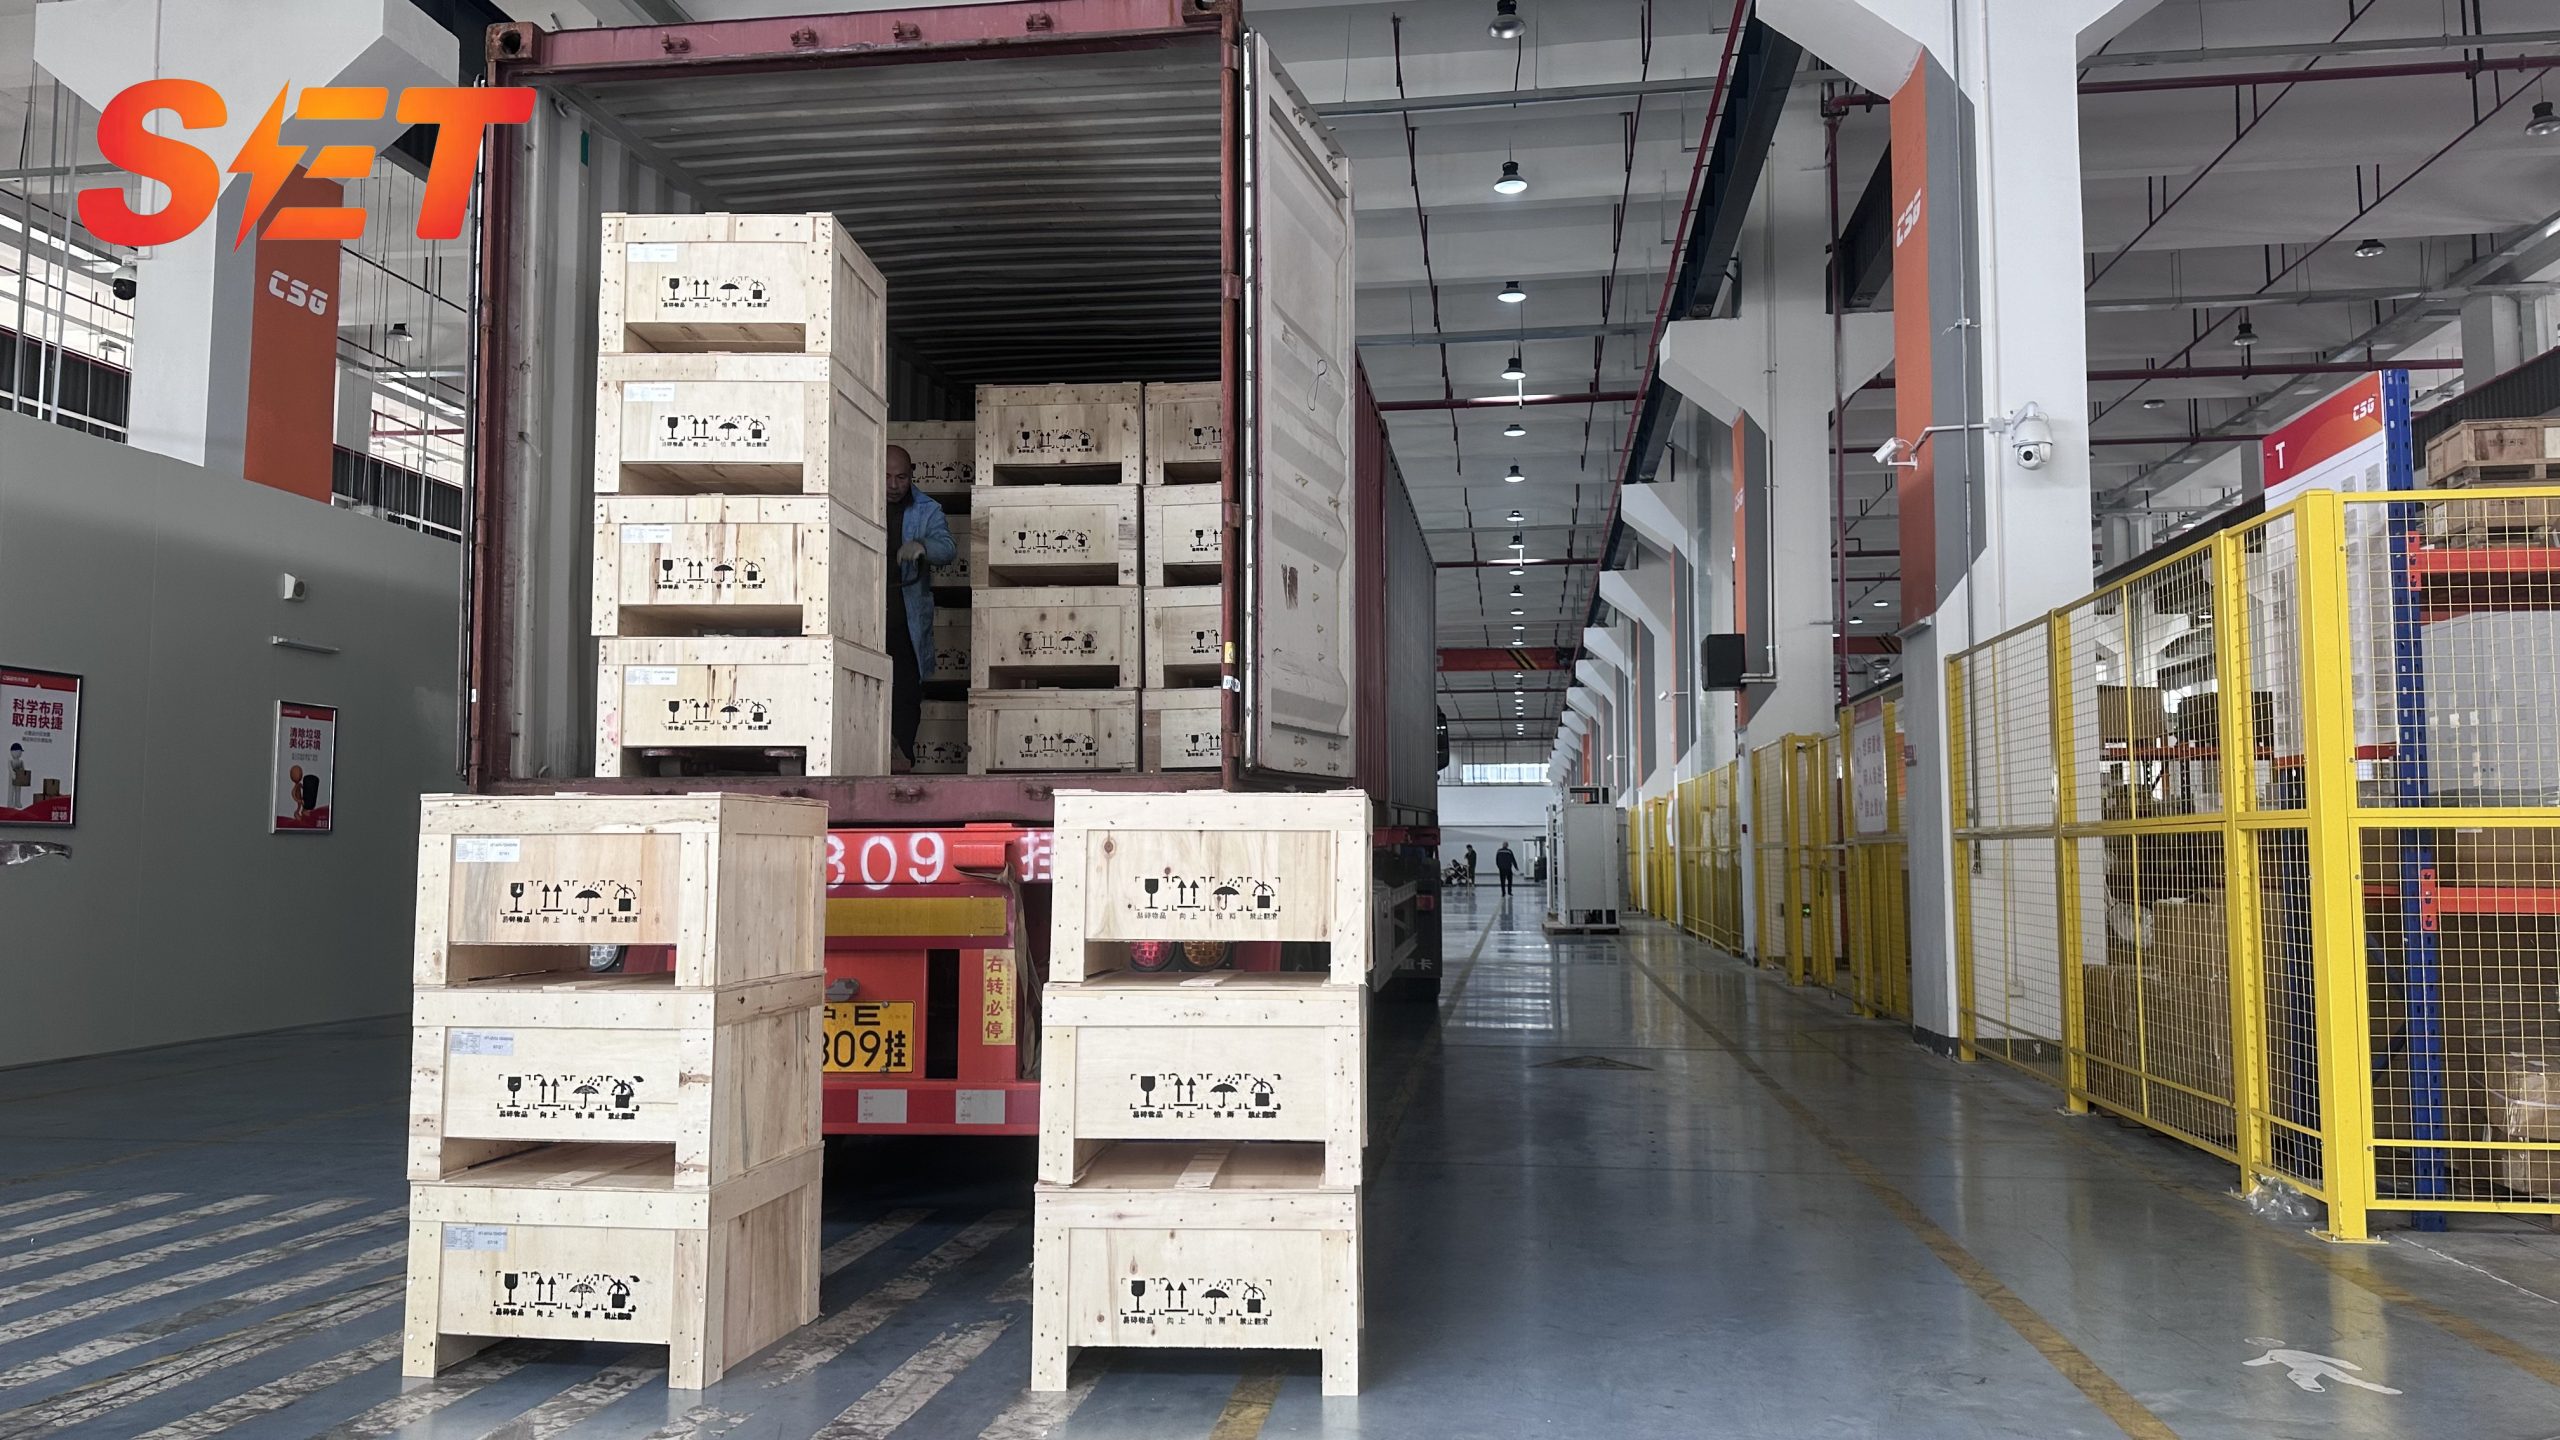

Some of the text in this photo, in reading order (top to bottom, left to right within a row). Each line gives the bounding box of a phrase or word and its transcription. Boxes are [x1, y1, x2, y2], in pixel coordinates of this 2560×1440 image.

[268, 270, 329, 316] CSG
[2352, 397, 2375, 421] CSG
[12, 698, 64, 717] 科学布局
[12, 713, 63, 731] 取用快捷
[289, 738, 321, 751] 美化环境
[542, 915, 560, 923] 向上
[1179, 912, 1198, 920] 向上
[985, 955, 1004, 1039] 右转必停
[539, 1111, 558, 1119] 向上
[1176, 1111, 1195, 1119] 向上
[536, 1309, 555, 1318] 向上
[1166, 1316, 1186, 1325] 向上
